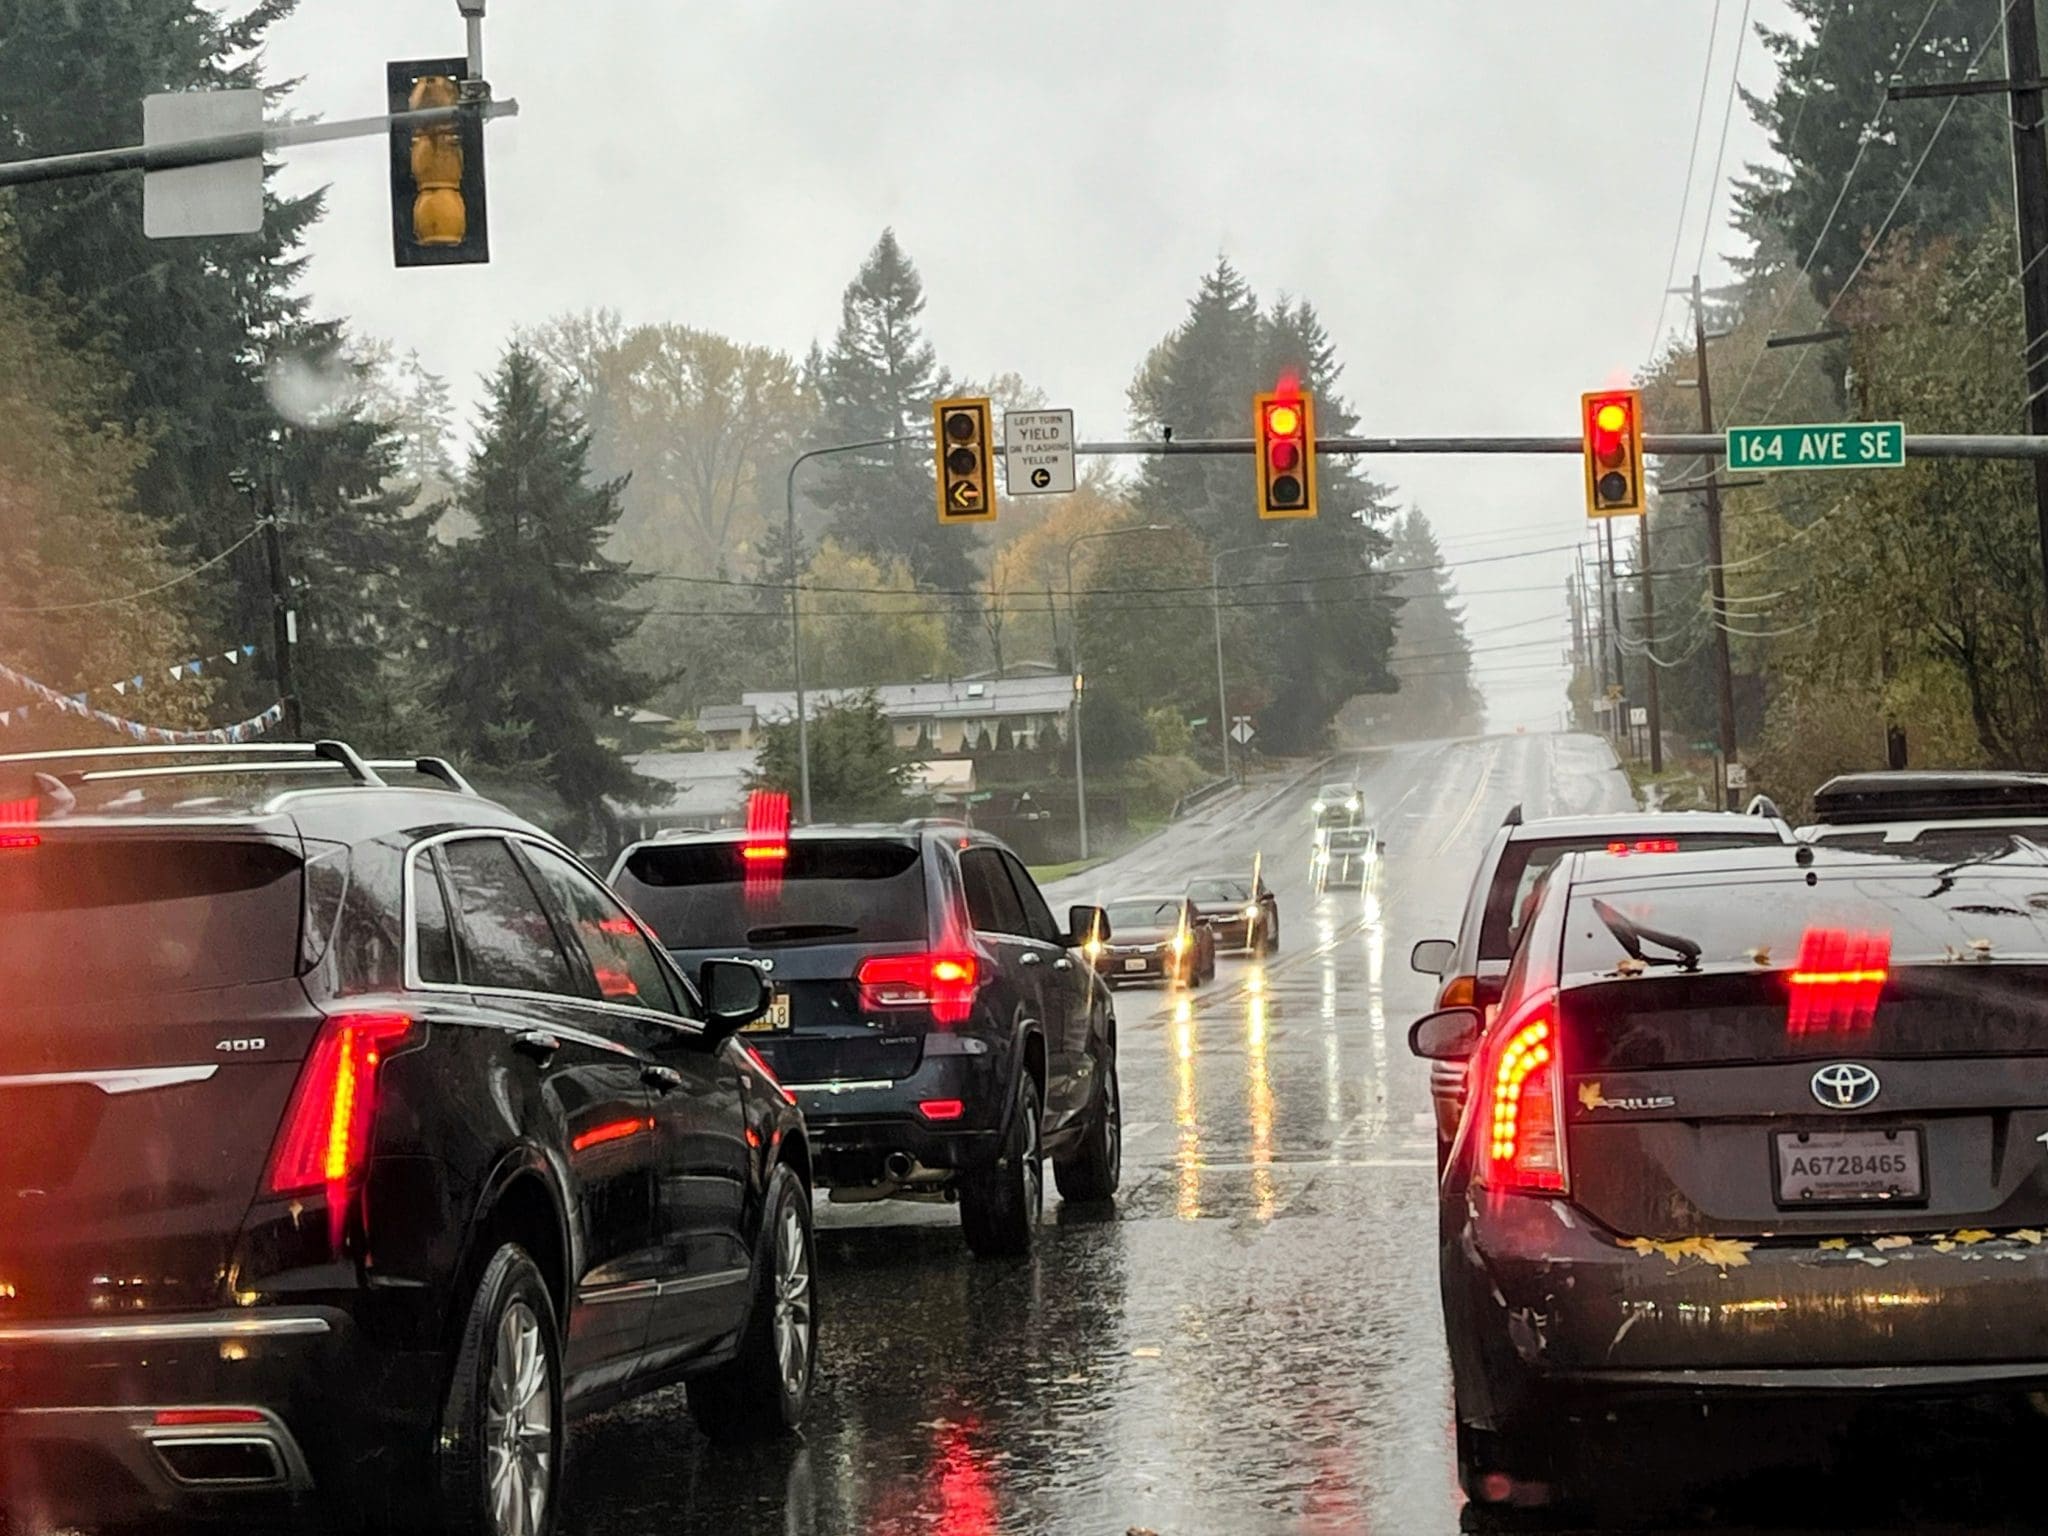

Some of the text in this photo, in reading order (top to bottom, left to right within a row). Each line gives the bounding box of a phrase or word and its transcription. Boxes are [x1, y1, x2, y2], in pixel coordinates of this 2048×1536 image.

[1014, 415, 1063, 426] LEFT TURN
[1019, 427, 1059, 440] YIELD
[1025, 442, 1070, 453] FLASHING
[1739, 431, 1893, 463] 164 AVE SE
[1021, 455, 1059, 465] YELLOW
[215, 1038, 265, 1052] 400
[1594, 1095, 1676, 1111] RIUS
[1791, 1154, 1907, 1177] A6728465
